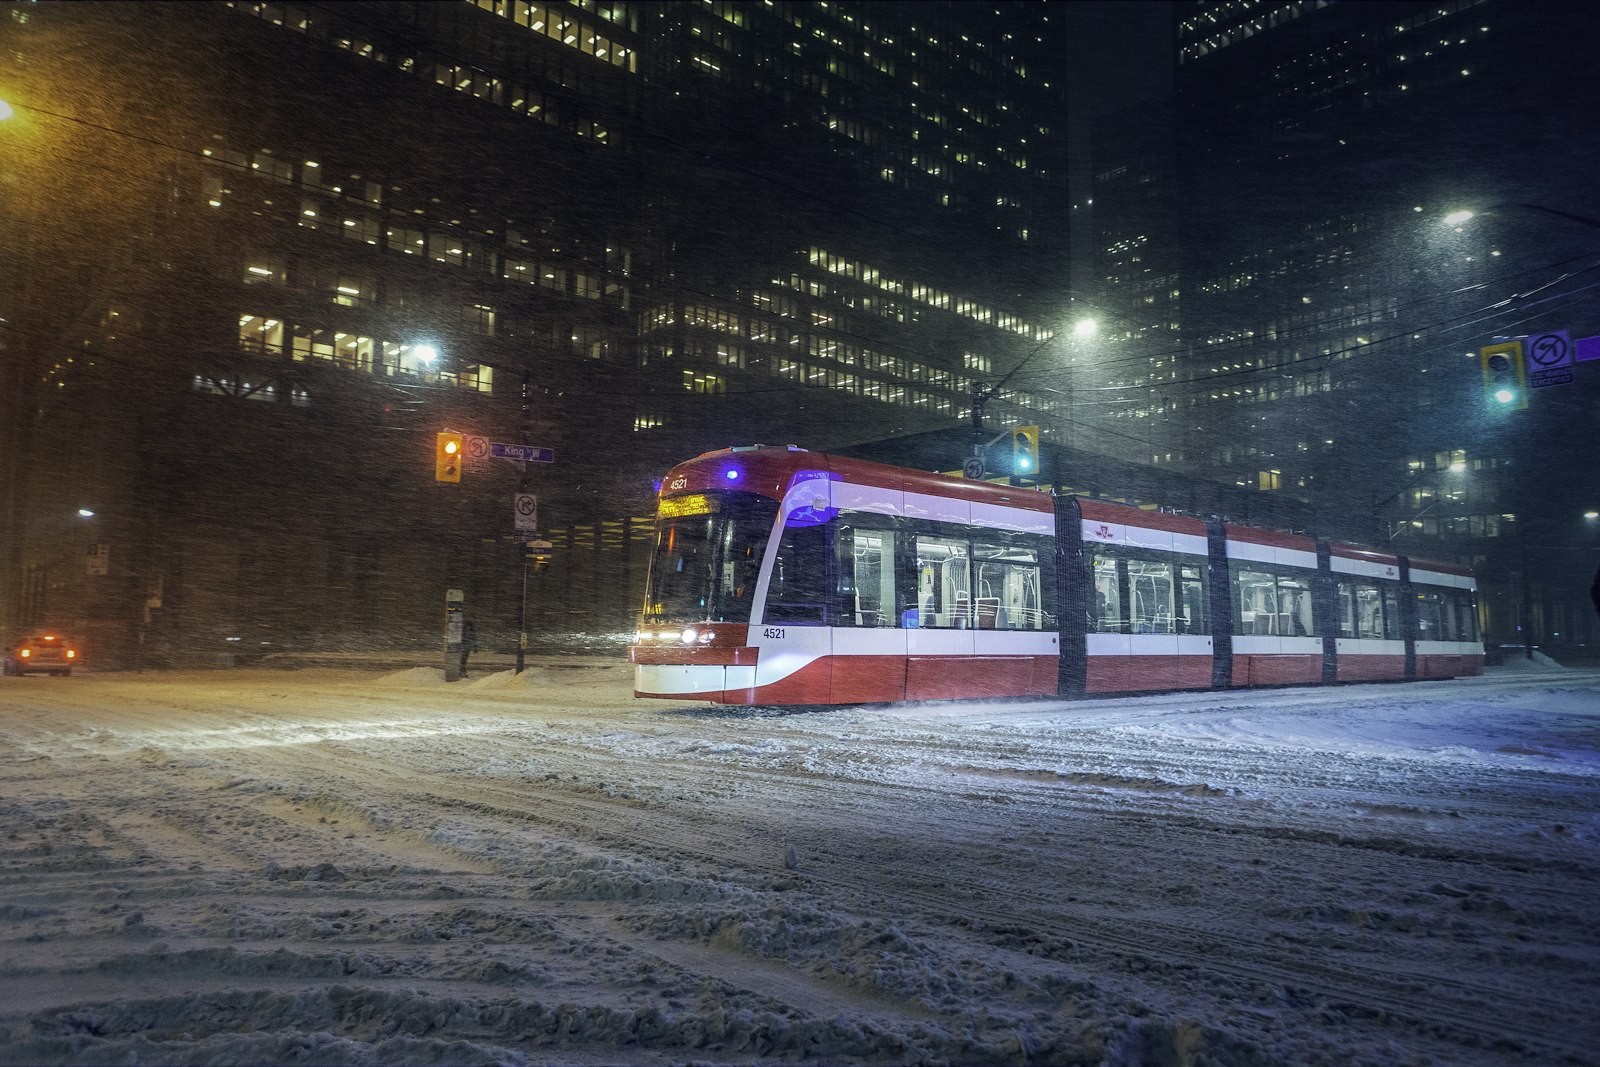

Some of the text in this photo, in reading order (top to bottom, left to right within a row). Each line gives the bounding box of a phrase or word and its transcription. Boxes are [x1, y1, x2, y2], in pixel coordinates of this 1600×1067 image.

[504, 445, 524, 459] King
[532, 449, 540, 458] W
[670, 478, 687, 490] 4521
[763, 628, 785, 639] 4521
